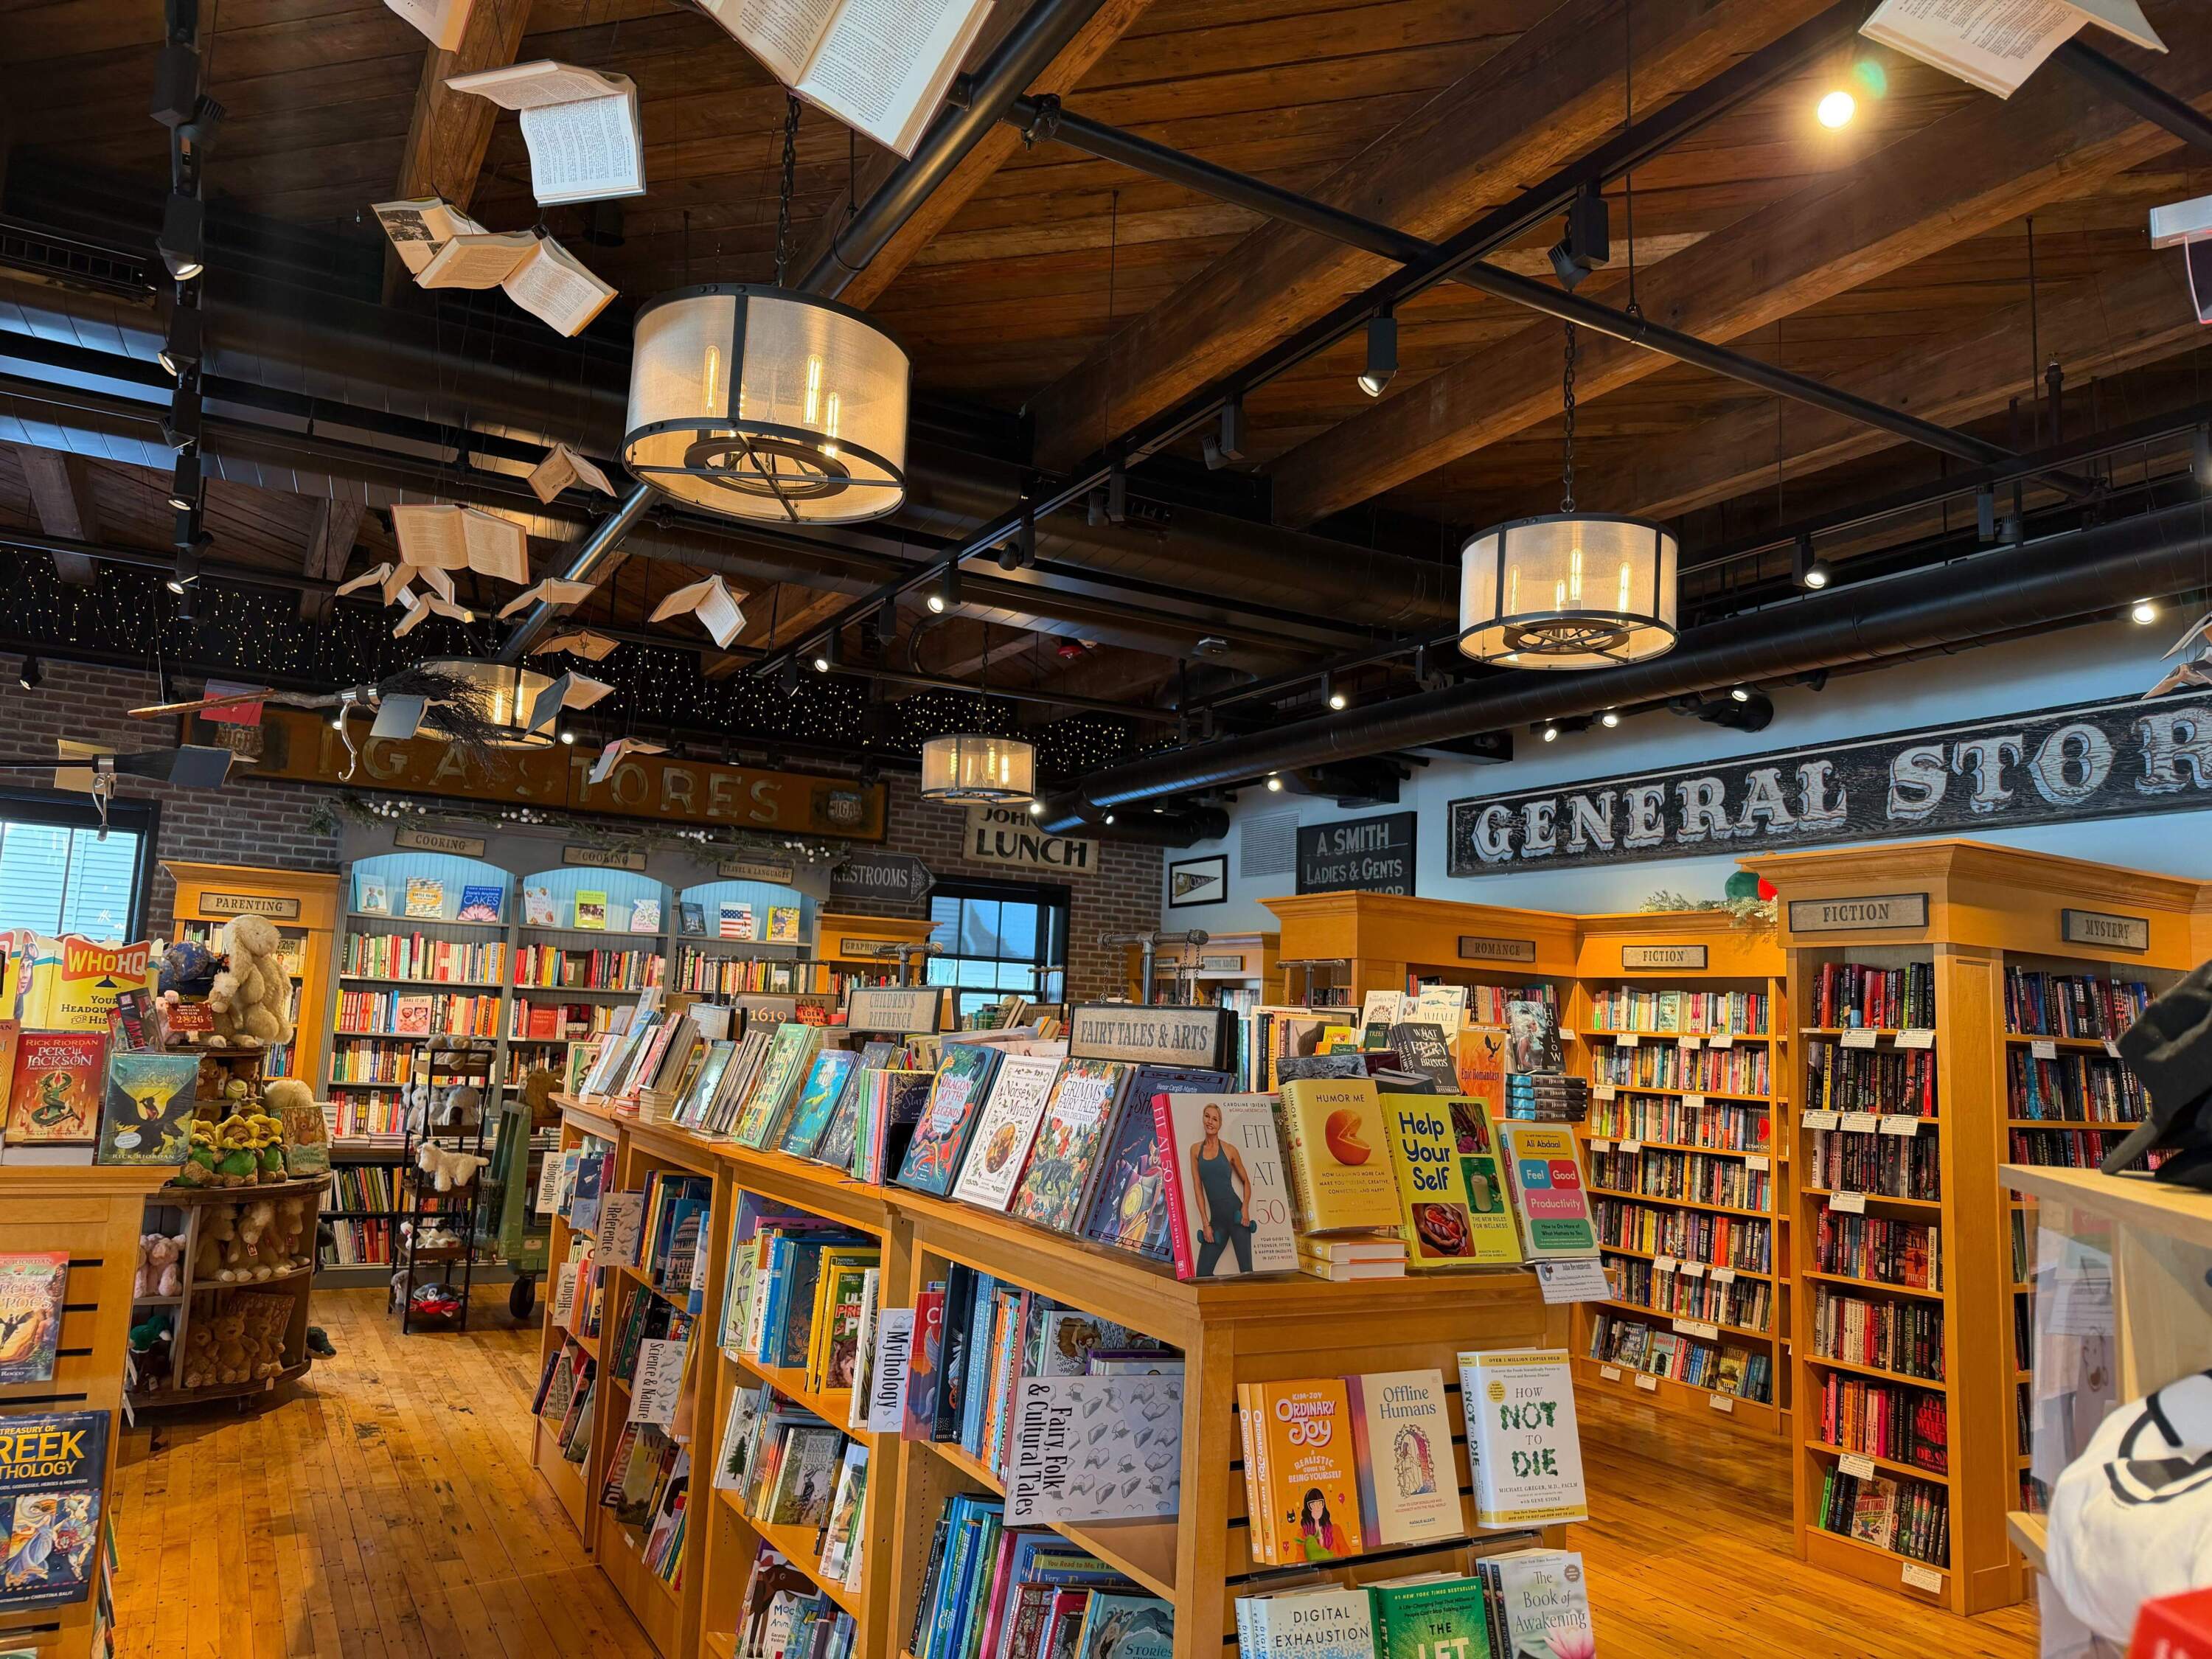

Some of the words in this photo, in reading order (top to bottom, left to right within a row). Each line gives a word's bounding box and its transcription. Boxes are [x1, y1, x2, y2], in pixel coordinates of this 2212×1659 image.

[1473, 759, 1846, 863] GENERAL
[1888, 707, 2212, 820] STOR
[414, 834, 467, 850] COOKING
[976, 829, 1088, 867] LUNCH
[1316, 831, 1331, 857] A.
[1334, 822, 1389, 854] SMITH
[582, 849, 629, 866] COOKING
[754, 868, 790, 878] LANGUAGES
[833, 863, 908, 888] ESTROOMS
[1307, 861, 1346, 883] LADIES
[1349, 860, 1360, 880] &
[1362, 857, 1402, 878] GENTS
[215, 897, 285, 913] PARENTING
[463, 896, 499, 905] CAKES
[1823, 902, 1891, 922] FICTION
[2085, 919, 2131, 940] MYSTERY
[1475, 941, 1521, 958] ROMANCE
[1643, 949, 1684, 964] FICTION
[67, 946, 147, 976] WHOHQ
[869, 993, 916, 1009] CHILDREN'S
[72, 1015, 87, 1024] FOR
[749, 1006, 787, 1024] 1619
[868, 1012, 912, 1028] REFERENCE
[1423, 1012, 1457, 1021] WHALE
[1080, 1020, 1116, 1044] FAIRY
[1117, 1022, 1155, 1047] TALES
[1158, 1023, 1169, 1048] &
[1171, 1025, 1208, 1051] ARTS
[1413, 1028, 1438, 1037] WHAT
[1543, 1008, 1562, 1063] HOLLOW
[26, 1039, 52, 1047] RICK
[53, 1038, 99, 1046] RIORDAN
[38, 1046, 83, 1057] PERCY
[26, 1054, 95, 1069] JACKSON
[1420, 1058, 1448, 1067] BRINGS
[942, 1076, 970, 1091] DRAGON
[1461, 1068, 1472, 1081] Epic
[1472, 1068, 1500, 1082] Romantasy
[940, 1090, 965, 1102] MYTHS
[1004, 1081, 1027, 1099] Norse
[1062, 1080, 1106, 1102] GRIMMS'
[1169, 1084, 1198, 1093] Cargill-Martin
[1057, 1096, 1079, 1111] FAIRY
[1078, 1099, 1100, 1115] TALES
[1316, 1094, 1351, 1103] HUMOR
[1353, 1094, 1366, 1103] ME
[932, 1105, 963, 1119] LEGENDS
[1006, 1099, 1034, 1119] Myths
[1153, 1107, 1166, 1130] FIT
[1398, 1111, 1444, 1142] Help
[1242, 1124, 1270, 1149] FIT
[1280, 1091, 1289, 1122] HUMOR
[1285, 1124, 1291, 1136] ME
[1290, 1155, 1299, 1180] CHRIS
[1287, 1088, 1297, 1121] HUMOR
[1293, 1121, 1299, 1133] ME
[1298, 1152, 1307, 1177] CHRIS
[1157, 1135, 1169, 1153] AT
[1402, 1139, 1450, 1164] Your
[1537, 1140, 1561, 1149] Abdaal
[1161, 1160, 1174, 1183] 50
[1252, 1161, 1276, 1186] AT
[1413, 1166, 1450, 1192] Self
[1526, 1169, 1545, 1180] Feel
[1552, 1170, 1576, 1180] Good
[542, 1163, 561, 1205] Biography
[1168, 1187, 1178, 1222] CAROLINE
[1256, 1199, 1287, 1225] 50
[1531, 1198, 1581, 1210] Productivity
[602, 1208, 622, 1253] Reference
[1906, 1273, 1919, 1283] THE
[557, 1280, 575, 1310] History
[645, 1342, 665, 1377] Science
[877, 1331, 910, 1409] Mythology
[643, 1378, 658, 1386] &
[1028, 1383, 1051, 1397] &
[1293, 1392, 1322, 1400] KIM-JOY
[1383, 1385, 1429, 1403] Offline
[1516, 1387, 1543, 1399] HOW
[638, 1388, 657, 1419] Nature
[1276, 1398, 1336, 1422] ORDINARY
[1380, 1402, 1436, 1419] Humans
[1464, 1390, 1476, 1425] NOT
[1500, 1401, 1557, 1431] NOT
[0, 1425, 43, 1435] TREASURY
[44, 1425, 58, 1433] OF
[1020, 1400, 1049, 1467] Cultural
[1044, 1407, 1073, 1452] Fairy,
[1289, 1418, 1332, 1447] JOY
[1526, 1434, 1543, 1445] TO
[1294, 1455, 1334, 1470] REALISTIC
[1512, 1448, 1559, 1478] DIE
[1043, 1455, 1068, 1491] Folk
[1289, 1474, 1310, 1484] BEING
[1309, 1470, 1342, 1482] YOURSELF
[1015, 1470, 1042, 1517] Tales
[1059, 1560, 1075, 1568] Read
[1096, 1562, 1105, 1570] I'll
[1045, 1573, 1060, 1583] Very
[1492, 1565, 1501, 1591] NEPO
[1534, 1571, 1552, 1585] The
[30, 1592, 58, 1600] CHRISTINA
[1447, 1585, 1478, 1594] BESTSELLER
[1523, 1588, 1559, 1608] Book
[1561, 1590, 1571, 1608] of
[1293, 1606, 1351, 1624] DIGITAL
[1515, 1611, 1587, 1632] Awakening
[1275, 1627, 1369, 1648] EXHAUSTION
[1429, 1621, 1453, 1636] THE
